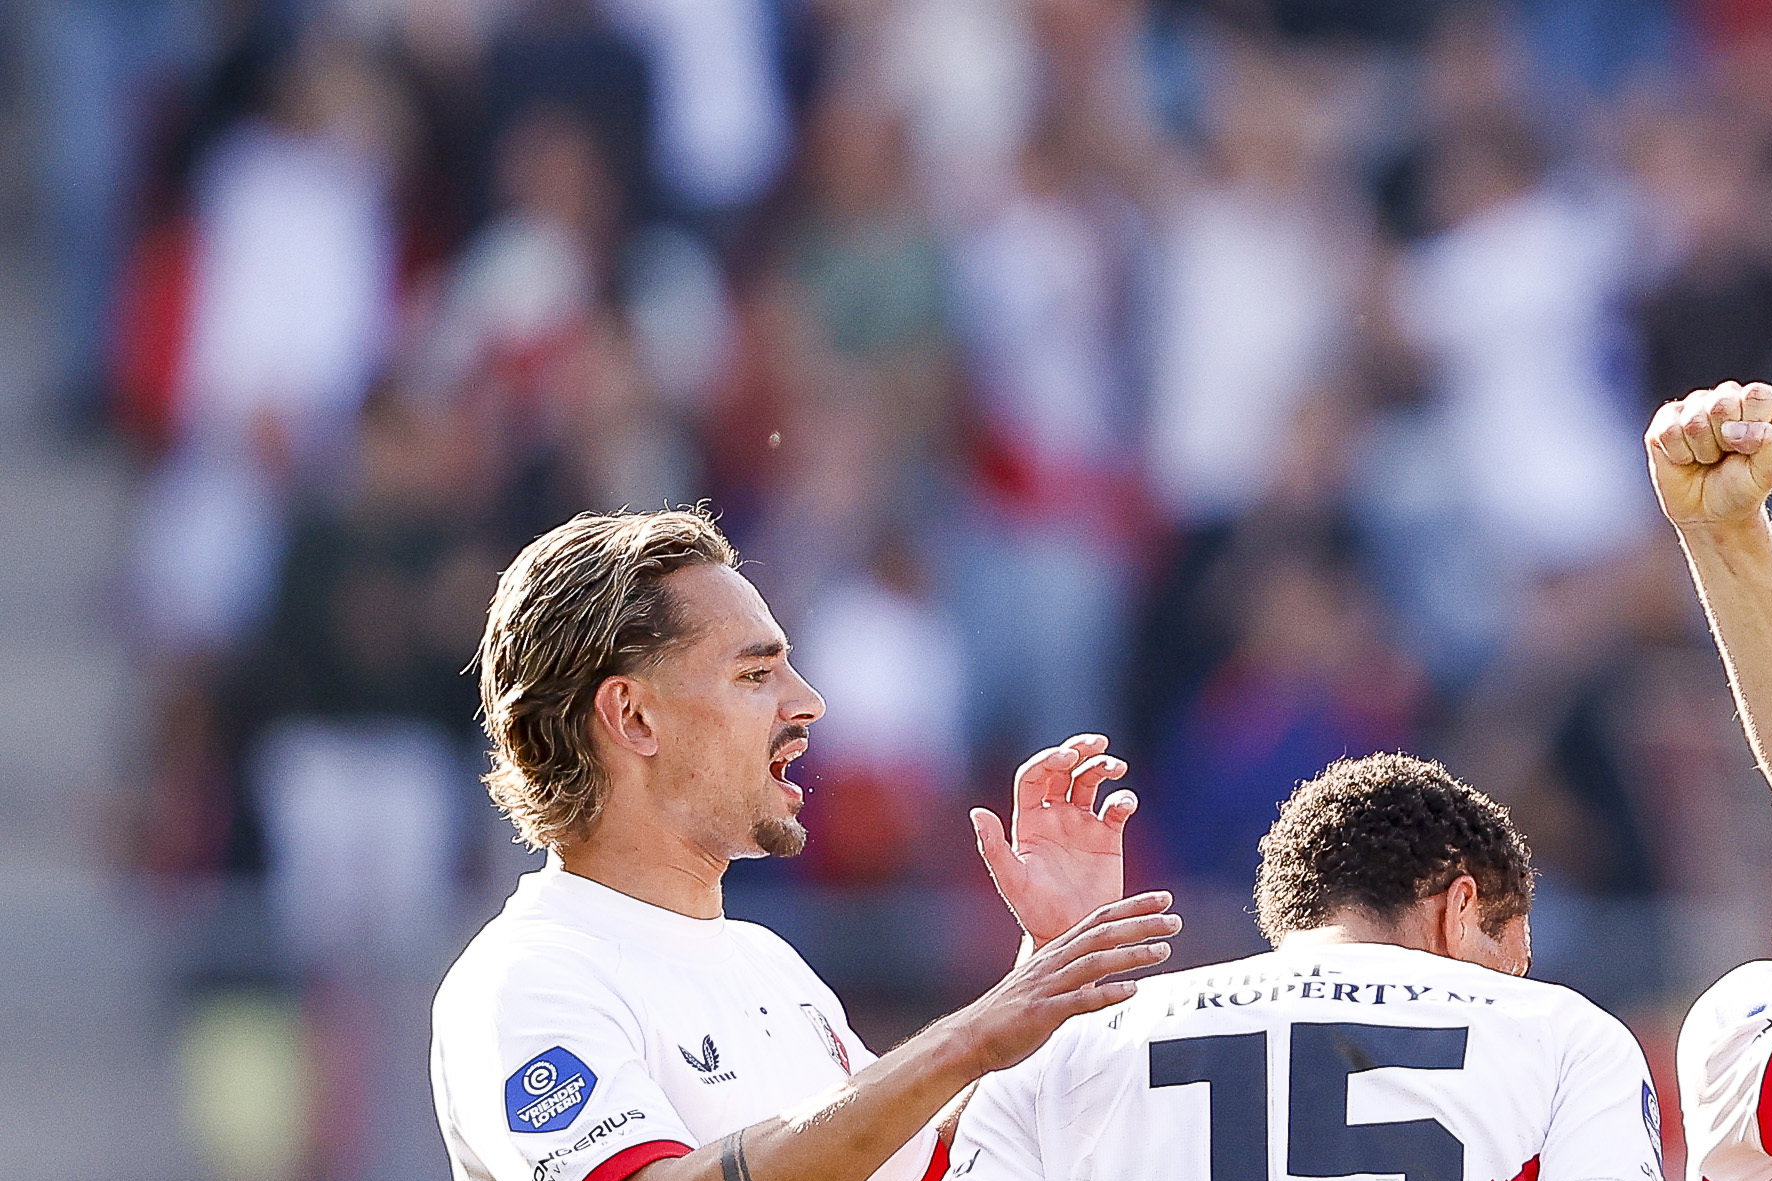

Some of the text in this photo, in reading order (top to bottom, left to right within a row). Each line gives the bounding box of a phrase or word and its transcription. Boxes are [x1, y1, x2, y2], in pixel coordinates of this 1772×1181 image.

[1166, 980, 1495, 1018] PROPERTYN
[518, 1077, 586, 1122] VRIENDEN
[530, 1091, 582, 1129] LOTERIJ
